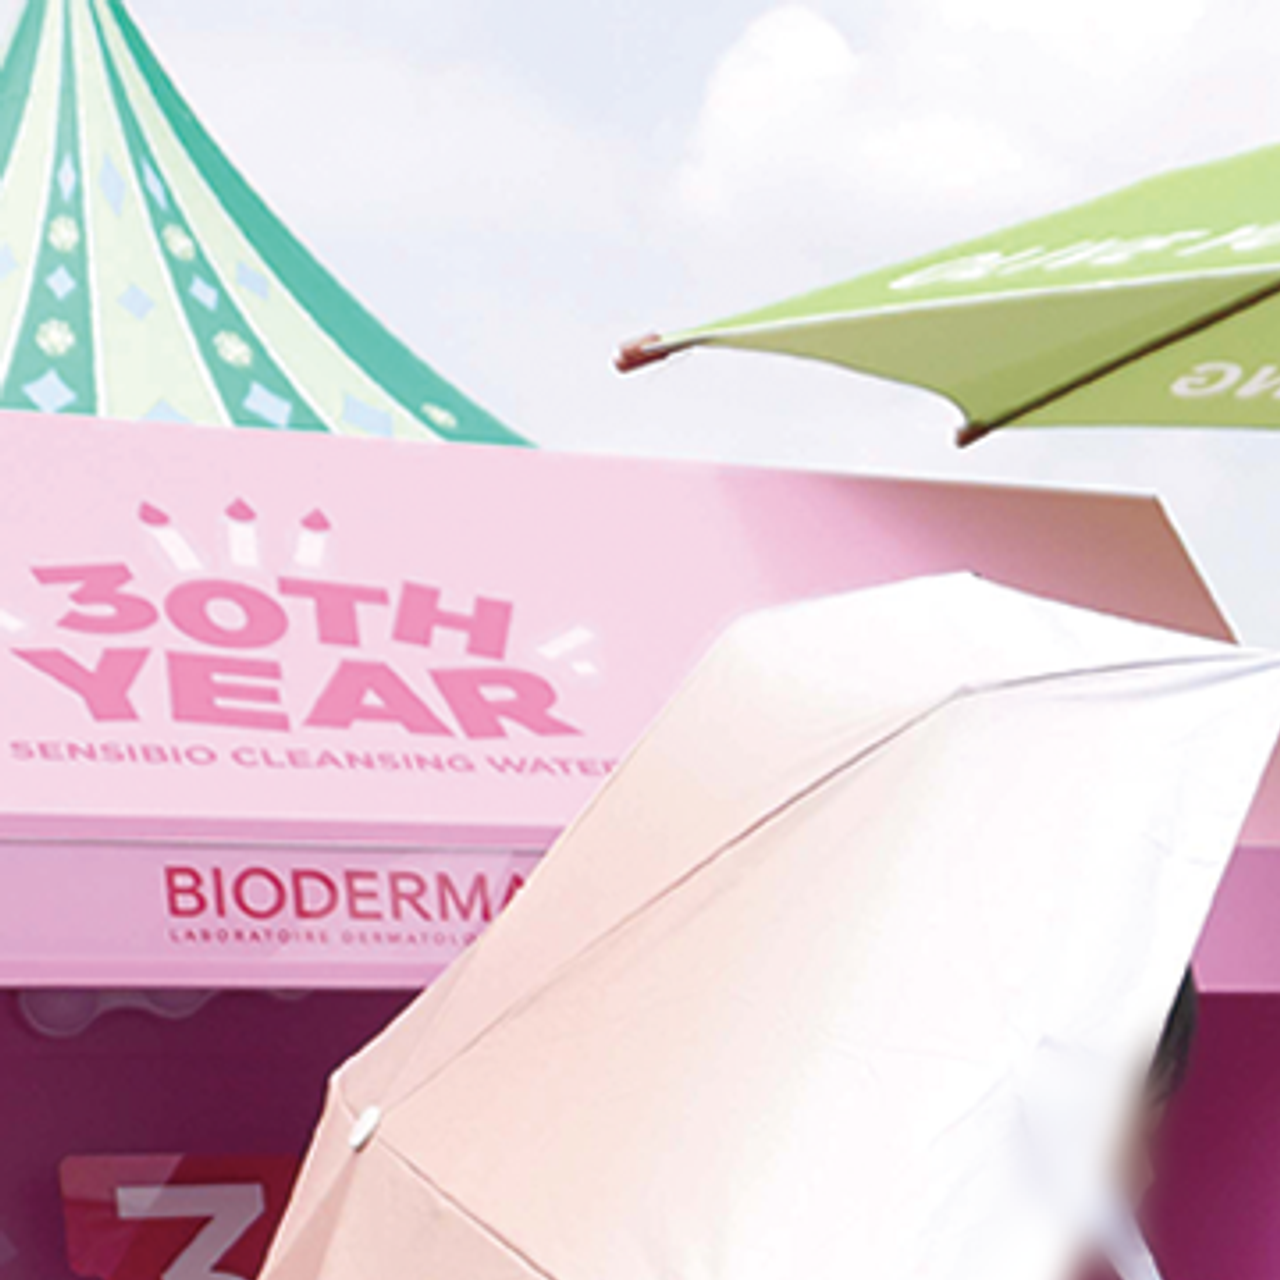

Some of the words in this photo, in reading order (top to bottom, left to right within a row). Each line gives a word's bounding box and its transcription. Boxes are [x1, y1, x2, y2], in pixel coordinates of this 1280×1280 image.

[8, 646, 585, 741] YEAR
[9, 740, 218, 768] SENSIBIO
[230, 746, 477, 775] CLEANSING
